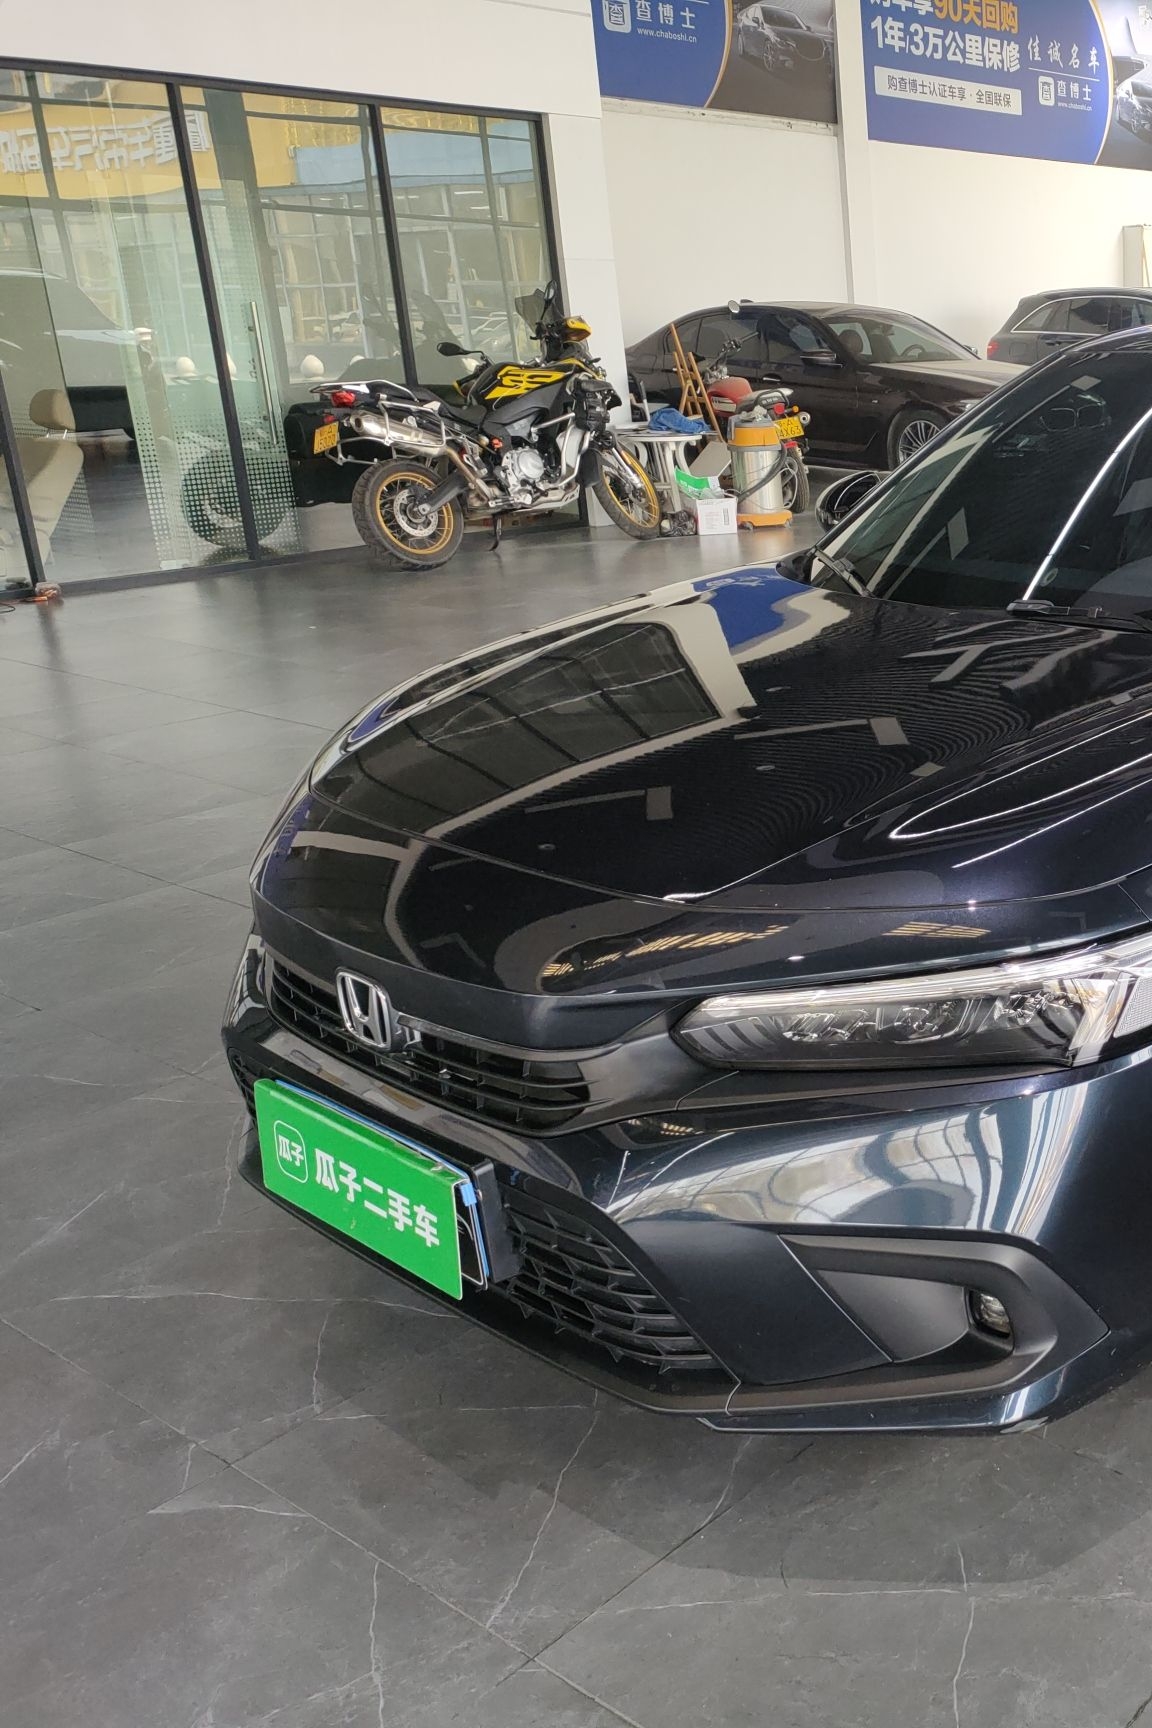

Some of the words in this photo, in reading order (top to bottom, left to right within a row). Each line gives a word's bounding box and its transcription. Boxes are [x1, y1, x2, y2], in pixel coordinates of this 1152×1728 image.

[636, 0, 696, 29] 查博士
[871, 0, 1018, 34] 享90天回购
[637, 27, 697, 43] www.chaboshi.cn
[870, 16, 1021, 72] 1年/3万公里保修
[1057, 80, 1092, 101] 查博士
[777, 425, 802, 437] 4X63
[278, 1134, 305, 1167] 瓜子
[315, 1148, 440, 1248] 瓜子二手车
